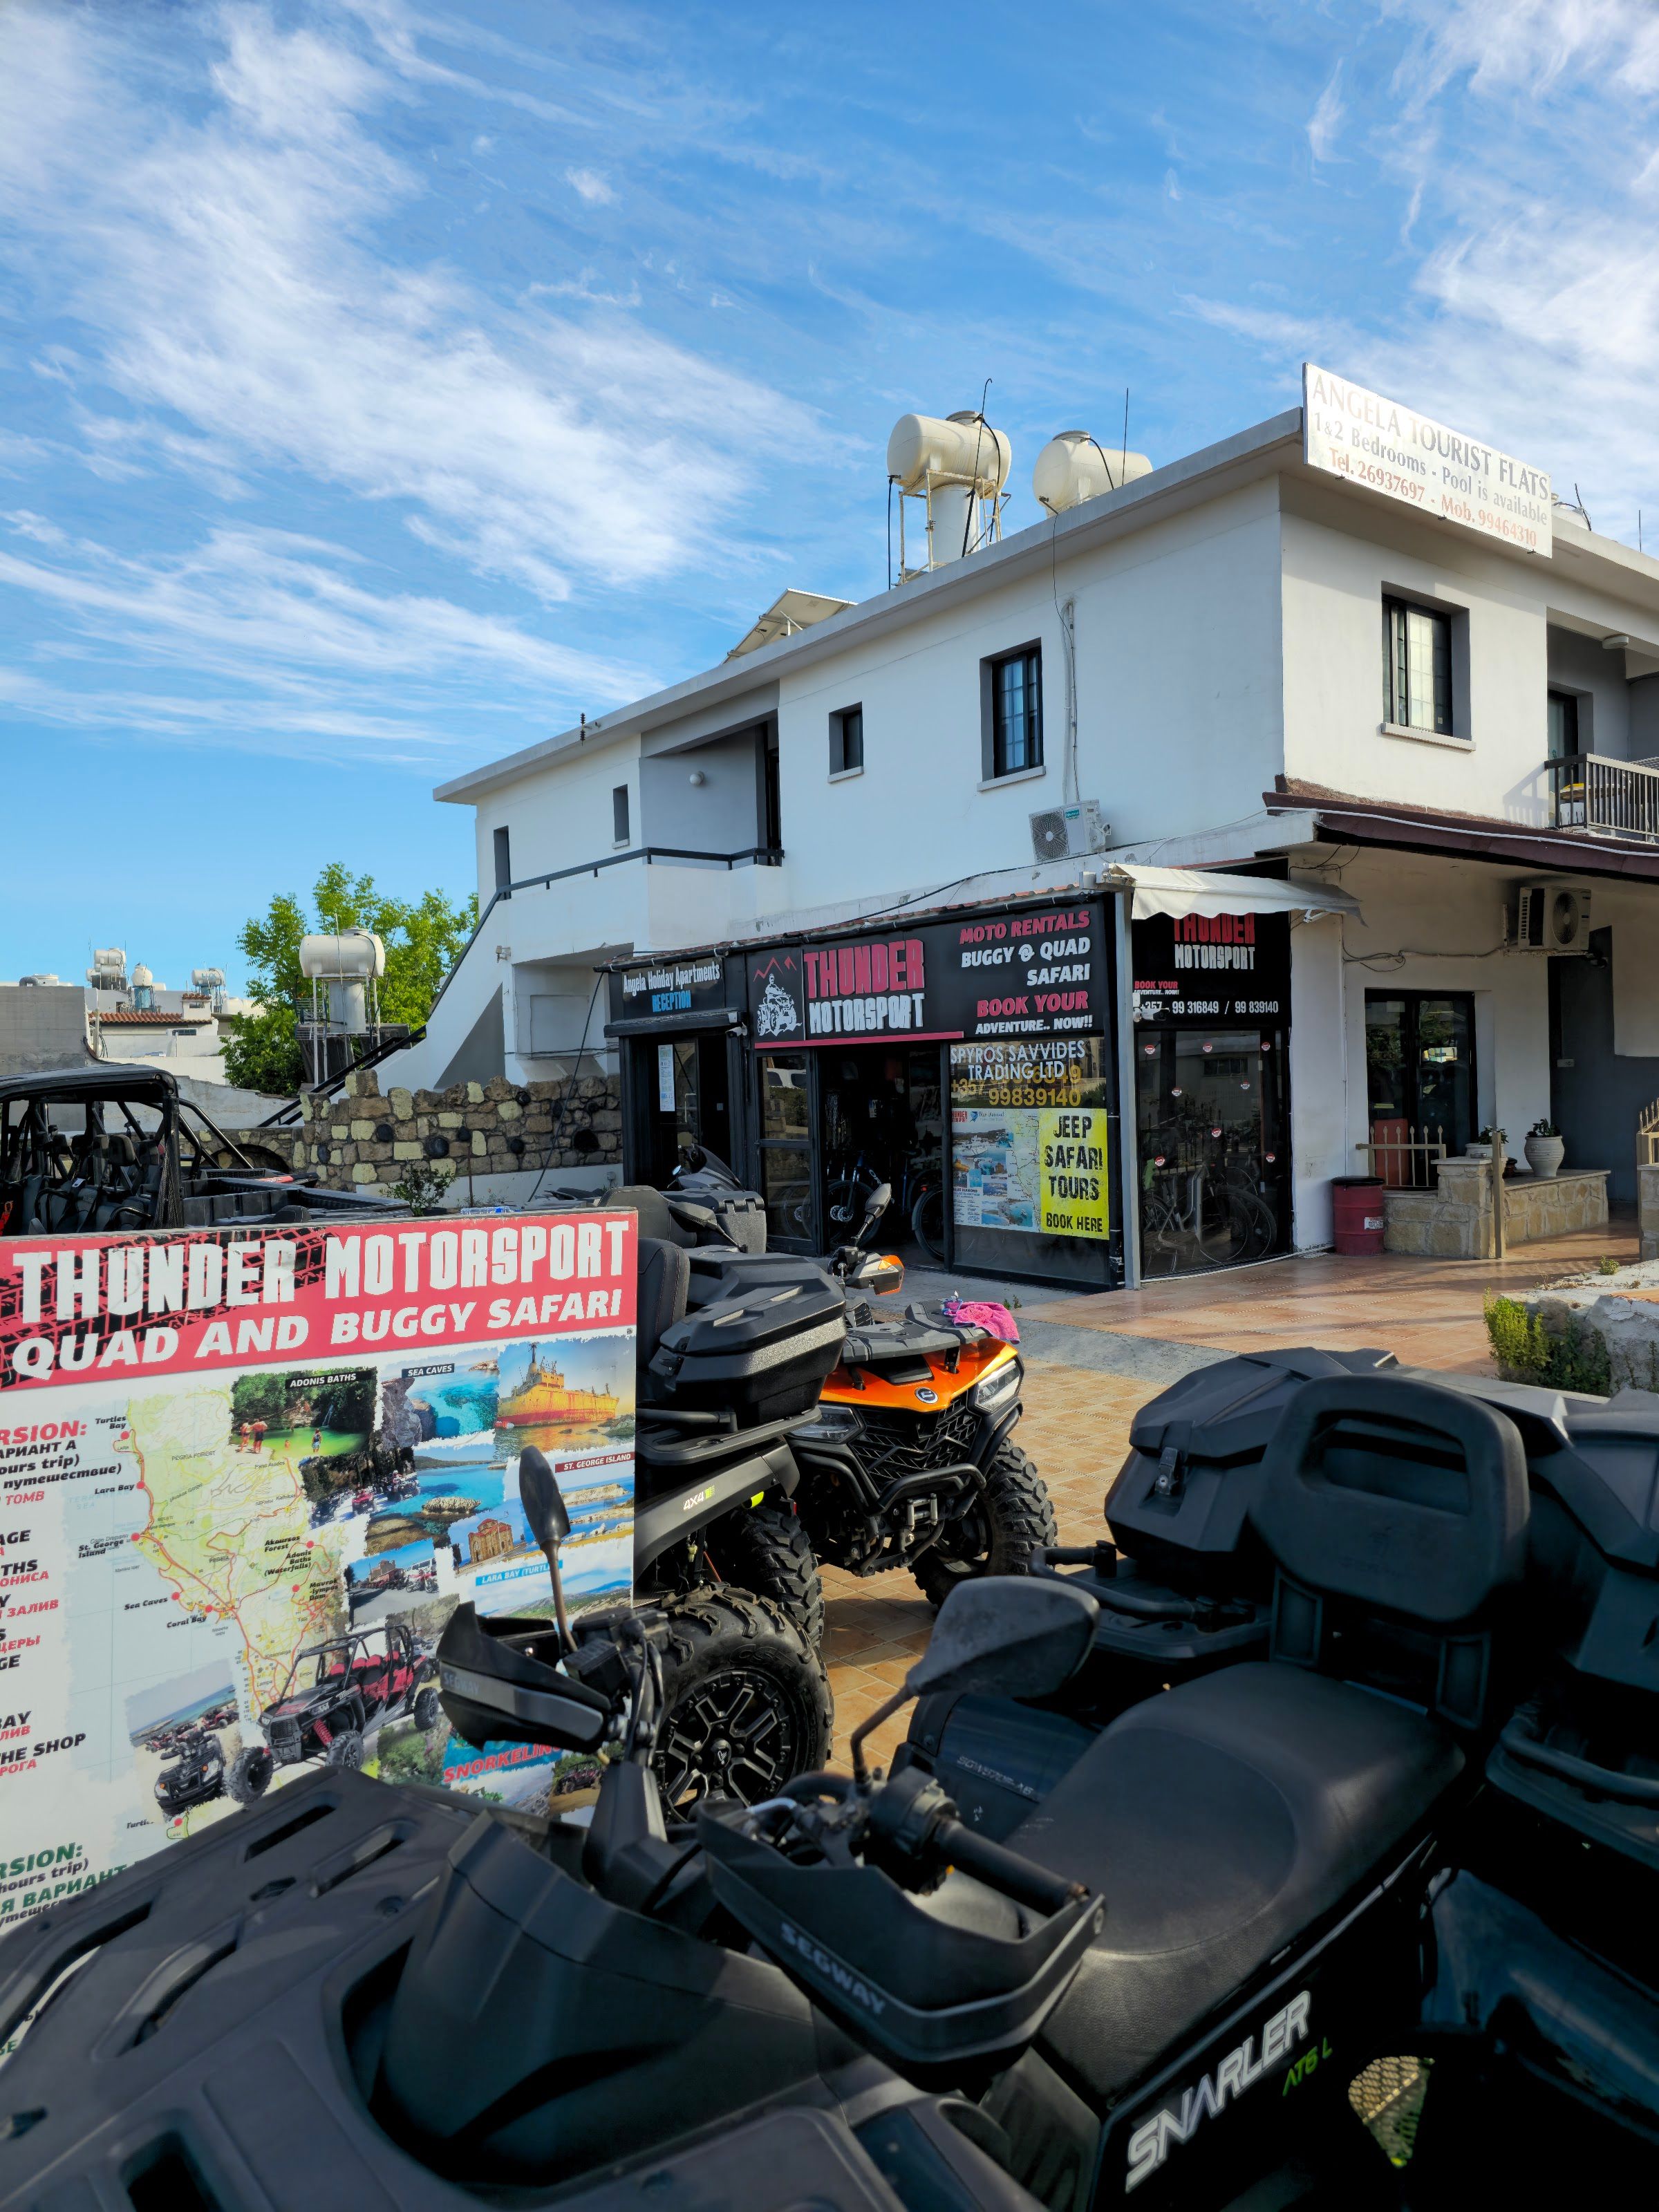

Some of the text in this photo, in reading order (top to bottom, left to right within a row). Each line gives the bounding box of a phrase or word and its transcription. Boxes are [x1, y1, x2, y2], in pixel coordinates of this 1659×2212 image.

[1313, 375, 1548, 500] ANGELA TOURIST FLATS
[1315, 413, 1343, 440] 1&2
[1352, 428, 1426, 476] Bedrooms
[1443, 467, 1472, 495] Pool
[1478, 480, 1488, 501] is
[1493, 491, 1547, 526] available
[1329, 447, 1353, 476] Tel.
[1358, 460, 1425, 503] 26937697
[1441, 494, 1475, 523] Mob.
[1478, 509, 1537, 547] 99464310
[959, 910, 1091, 945] MOTO RENTALS
[961, 946, 1016, 968] BUGGY
[1040, 937, 1091, 961] QUAD
[1174, 944, 1255, 970] MOTORSPORT
[624, 962, 720, 996] Angela Holiday Apartments
[803, 939, 925, 1000] THUNDER
[1027, 964, 1091, 986] SAFARI
[1134, 981, 1178, 989] BOOK YOUR
[652, 990, 691, 1013] RECEPTION
[977, 991, 1088, 1018] BOOK YOUR
[1172, 1001, 1185, 1014] 99
[1188, 1001, 1219, 1014] 316849
[1224, 1000, 1230, 1014] /
[1235, 1001, 1246, 1014] 99
[1248, 1001, 1279, 1013] 839140
[809, 993, 925, 1034] MOTORSPORT
[975, 1015, 1092, 1035] ADVENTURE.. NOW!!
[950, 1040, 1085, 1064] SPYROS SAVVIDES
[968, 1060, 1065, 1080] TRADING LTD
[989, 1088, 1081, 1106] 99839140
[1053, 1115, 1092, 1138] JEEP
[1044, 1145, 1103, 1170] SAFARI
[1048, 1175, 1100, 1201] TOURS
[1046, 1212, 1103, 1232] BOOK HERE
[12, 1221, 630, 1323] THUNDER MOTORSPORT
[12, 1288, 622, 1380] QUAD AND BUGGY SAFARI
[290, 1373, 356, 1387] ADONIS BATHS
[408, 1365, 452, 1377] SEA CAVES
[95, 1416, 126, 1425] Turtles
[41, 1453, 79, 1469] trip)
[563, 1453, 631, 1470] ST. GEORGE ISLAND
[78, 1548, 106, 1558] Island
[93, 1539, 124, 1549] George
[264, 1544, 288, 1553] Forest
[287, 1549, 312, 1559] Adonis
[1, 1559, 38, 1576] THS
[264, 1562, 312, 1577] (Waterfalls)
[482, 1564, 550, 1584] LARA BAY (TURTL
[310, 1578, 337, 1588] Mavrok
[7, 1599, 59, 1618] ЗАЛИВ
[124, 1596, 168, 1611] Sea Caves
[167, 1618, 189, 1628] Coral
[33, 1733, 86, 1756] SHOP
[52, 1858, 89, 1879] trip)
[781, 1922, 885, 2015] SEGWAY
[1125, 1990, 1311, 2194] SNARLER
